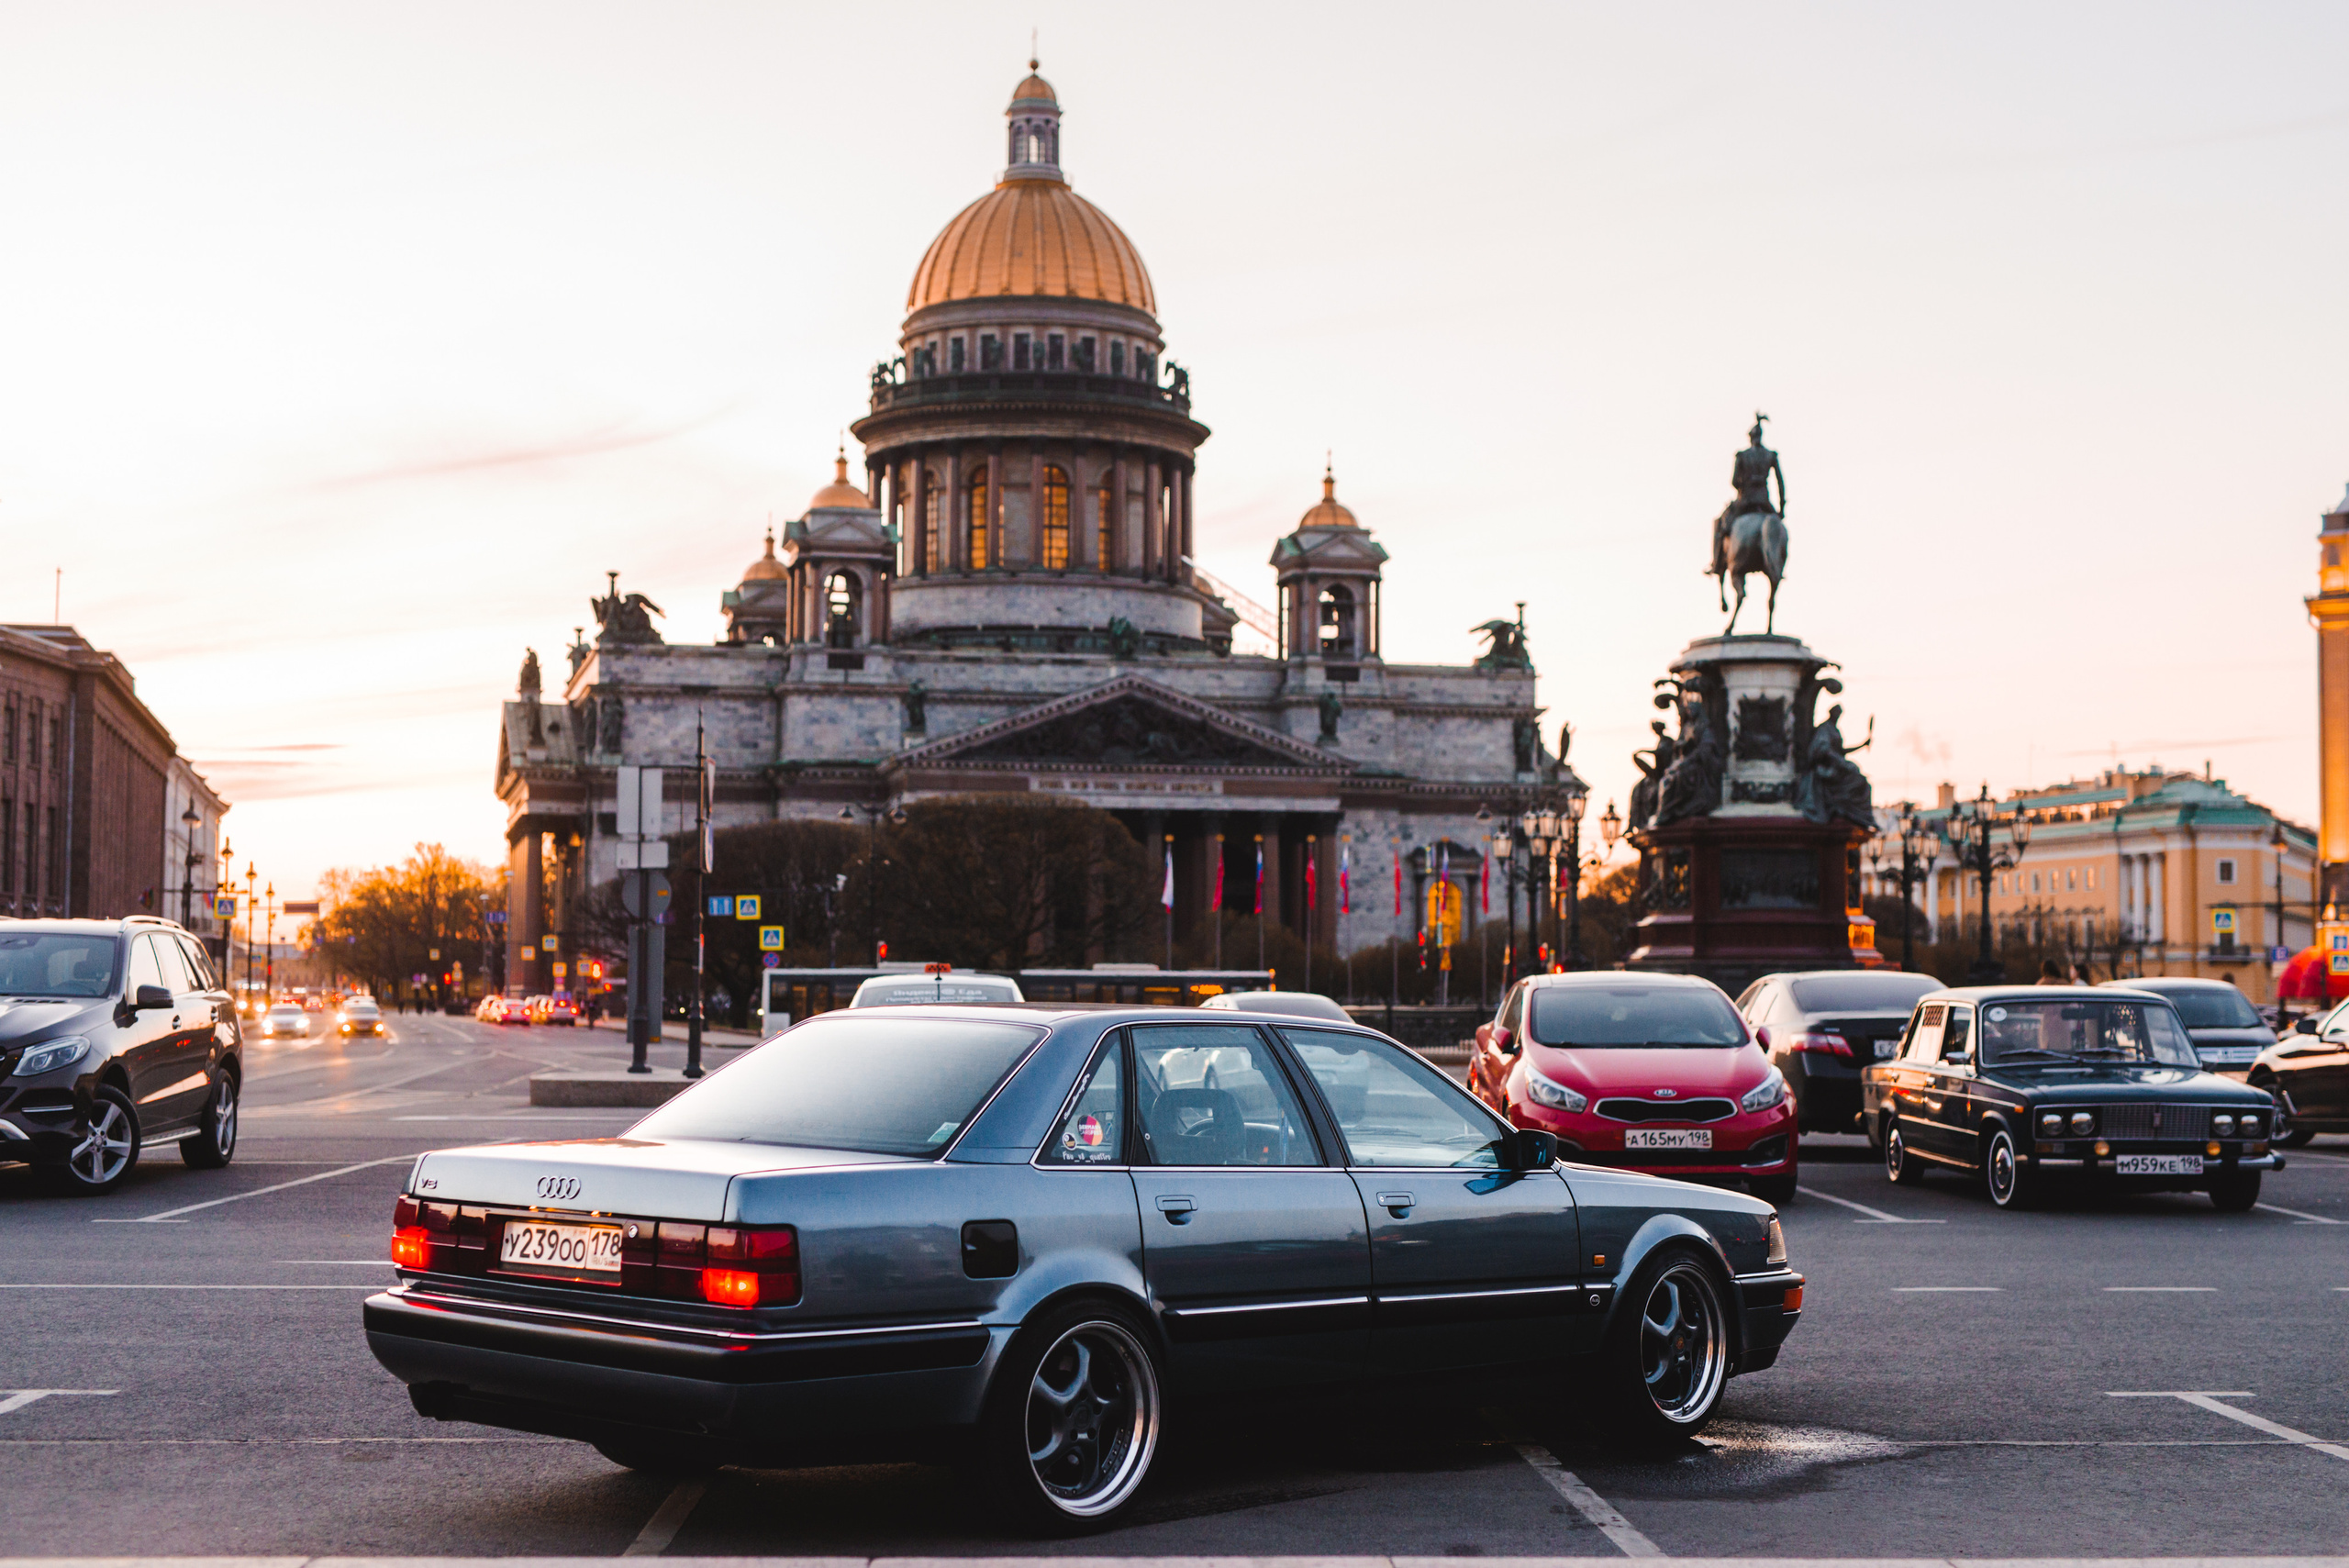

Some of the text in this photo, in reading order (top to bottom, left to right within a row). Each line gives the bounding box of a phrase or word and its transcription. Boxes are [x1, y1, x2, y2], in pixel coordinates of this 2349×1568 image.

[1688, 1131, 1709, 1143] 198
[2180, 1157, 2200, 1168] 198
[591, 1230, 620, 1257] 178
